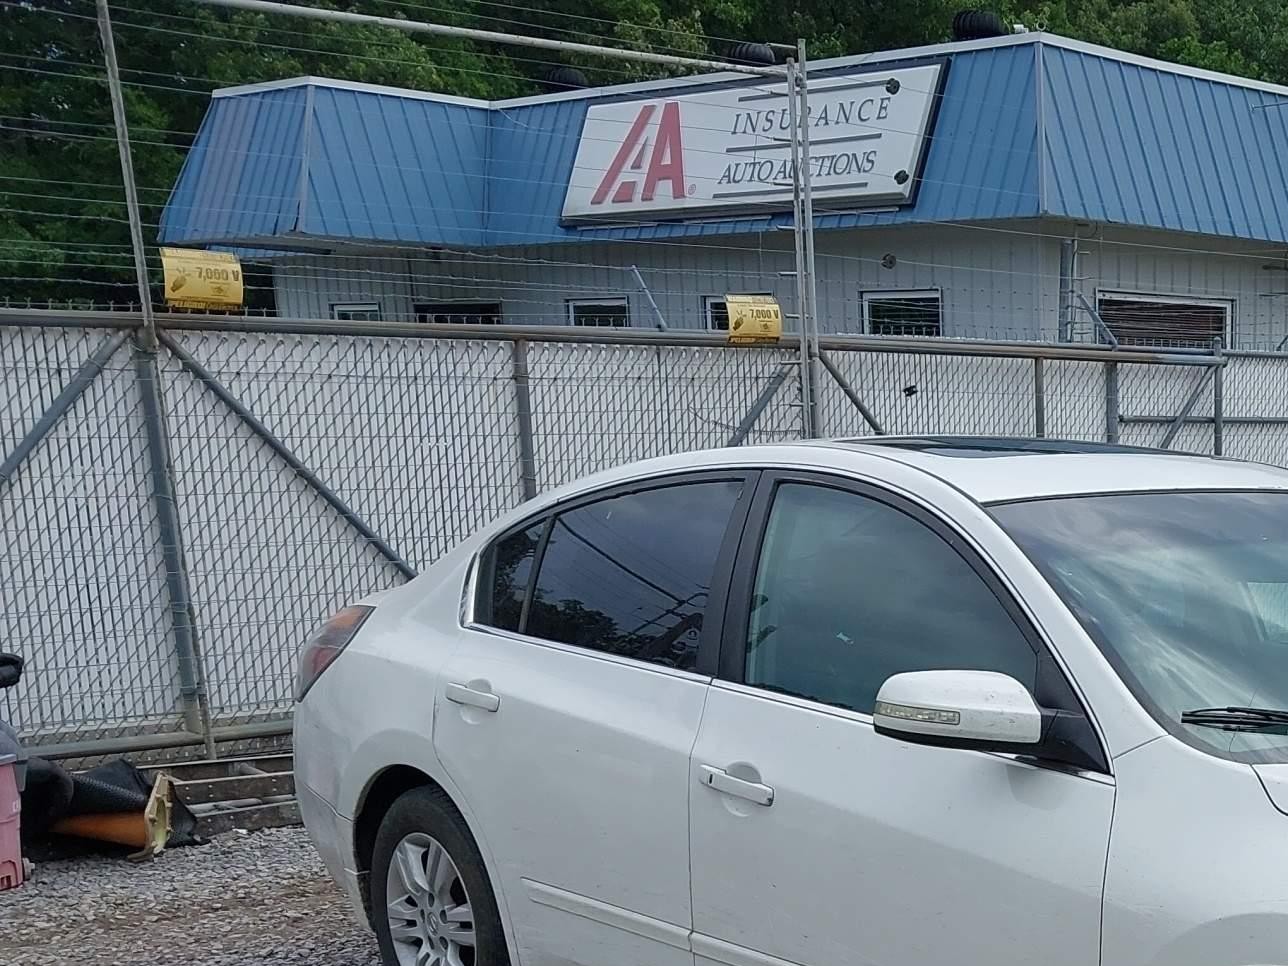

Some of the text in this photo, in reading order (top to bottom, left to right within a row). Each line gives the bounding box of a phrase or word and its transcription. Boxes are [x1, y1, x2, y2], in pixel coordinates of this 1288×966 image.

[717, 160, 774, 185] AUTO
[195, 267, 240, 282] 7,000 V
[749, 309, 779, 320] 7,000 V
